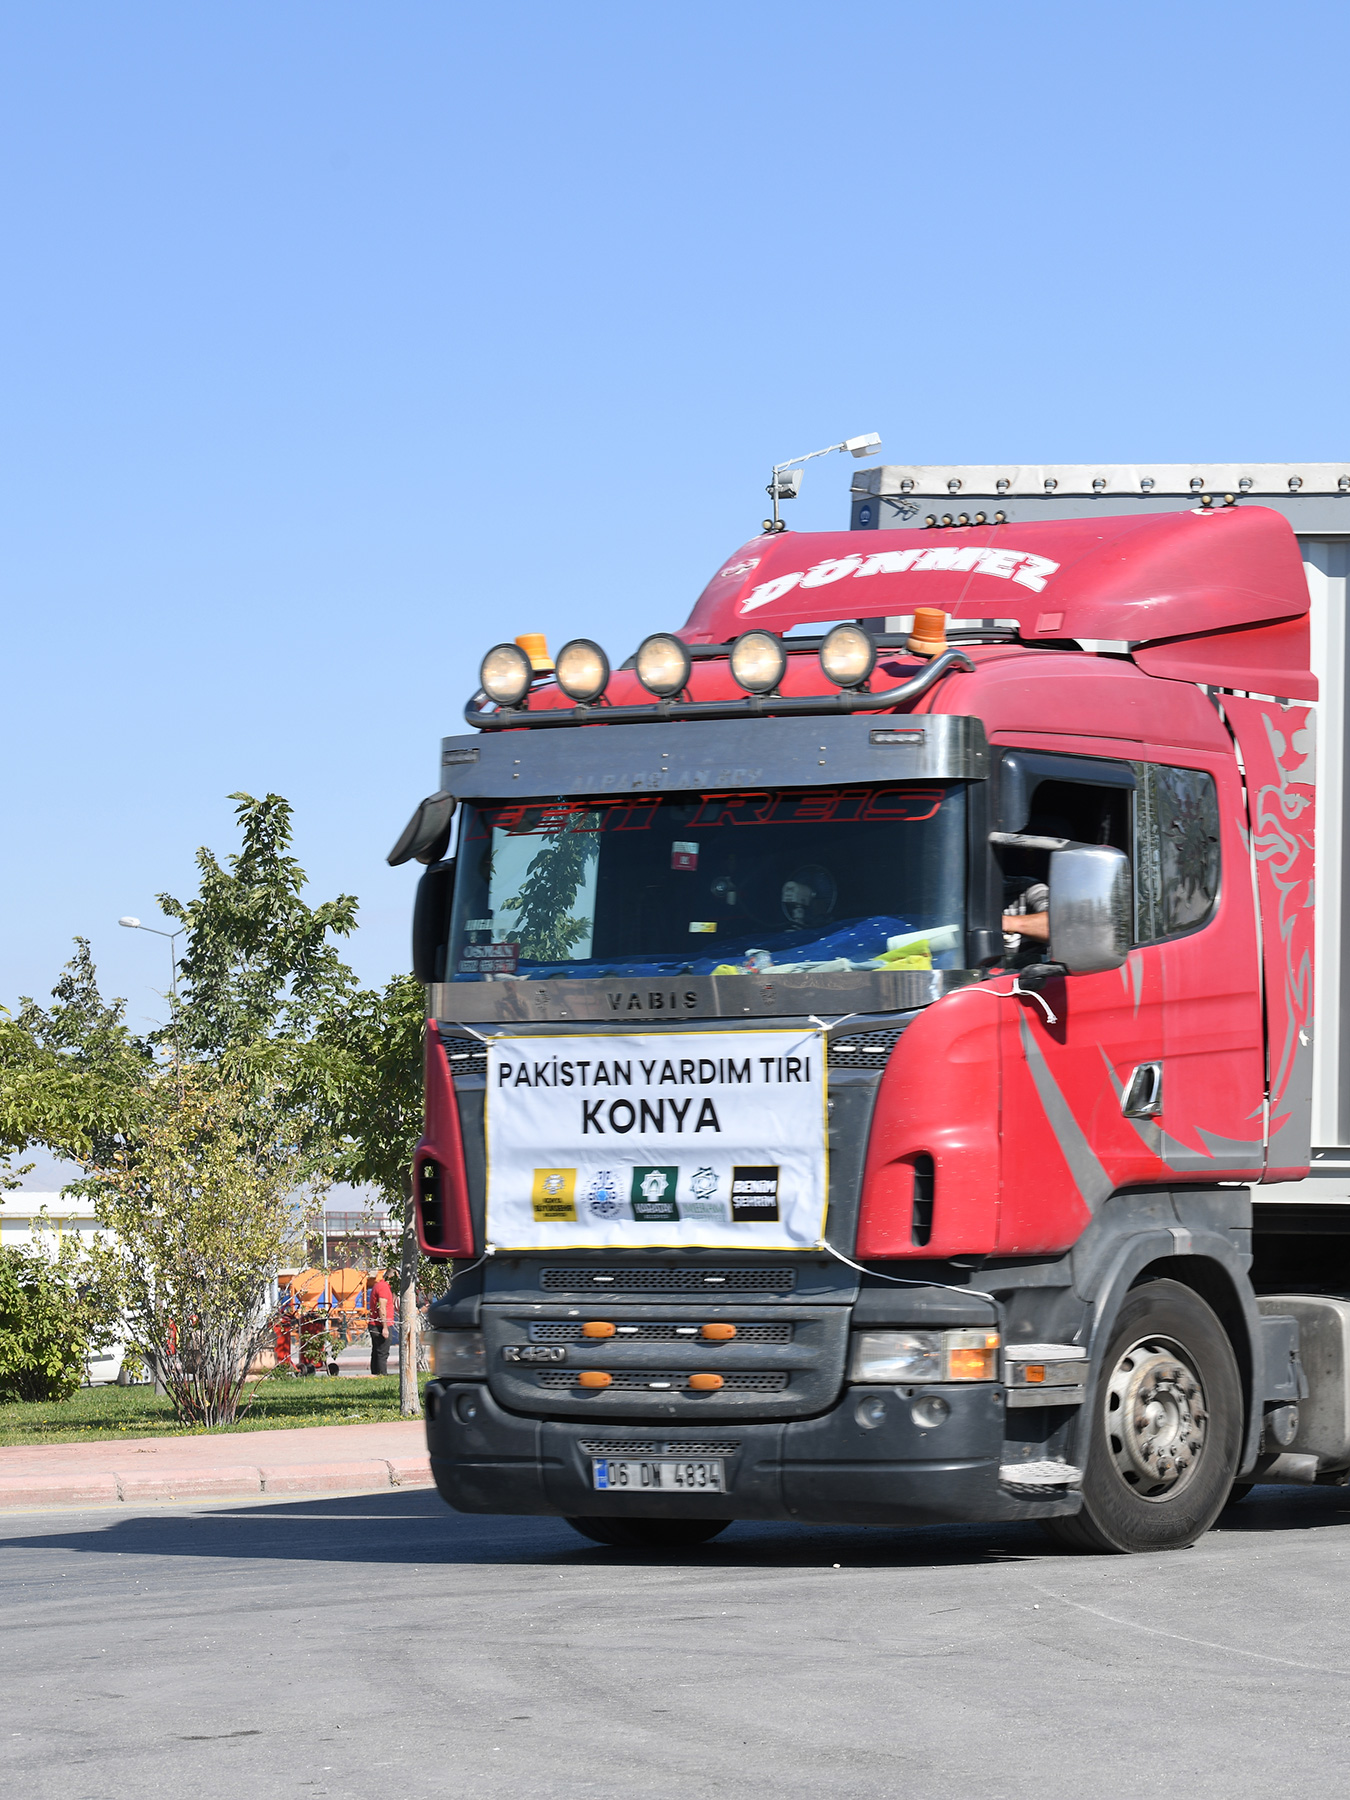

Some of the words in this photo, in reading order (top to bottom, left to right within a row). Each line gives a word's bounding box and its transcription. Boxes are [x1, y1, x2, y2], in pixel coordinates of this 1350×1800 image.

[740, 546, 1061, 614] DÖNMEZ
[606, 990, 699, 1011] VABIS
[498, 1055, 632, 1088] PAKİSTAN
[639, 1058, 752, 1086] YARDIM
[759, 1056, 811, 1084] TIRI
[582, 1098, 722, 1135] KONYA
[503, 1345, 566, 1362] R420
[608, 1463, 628, 1486] 06
[676, 1464, 721, 1488] 4834
